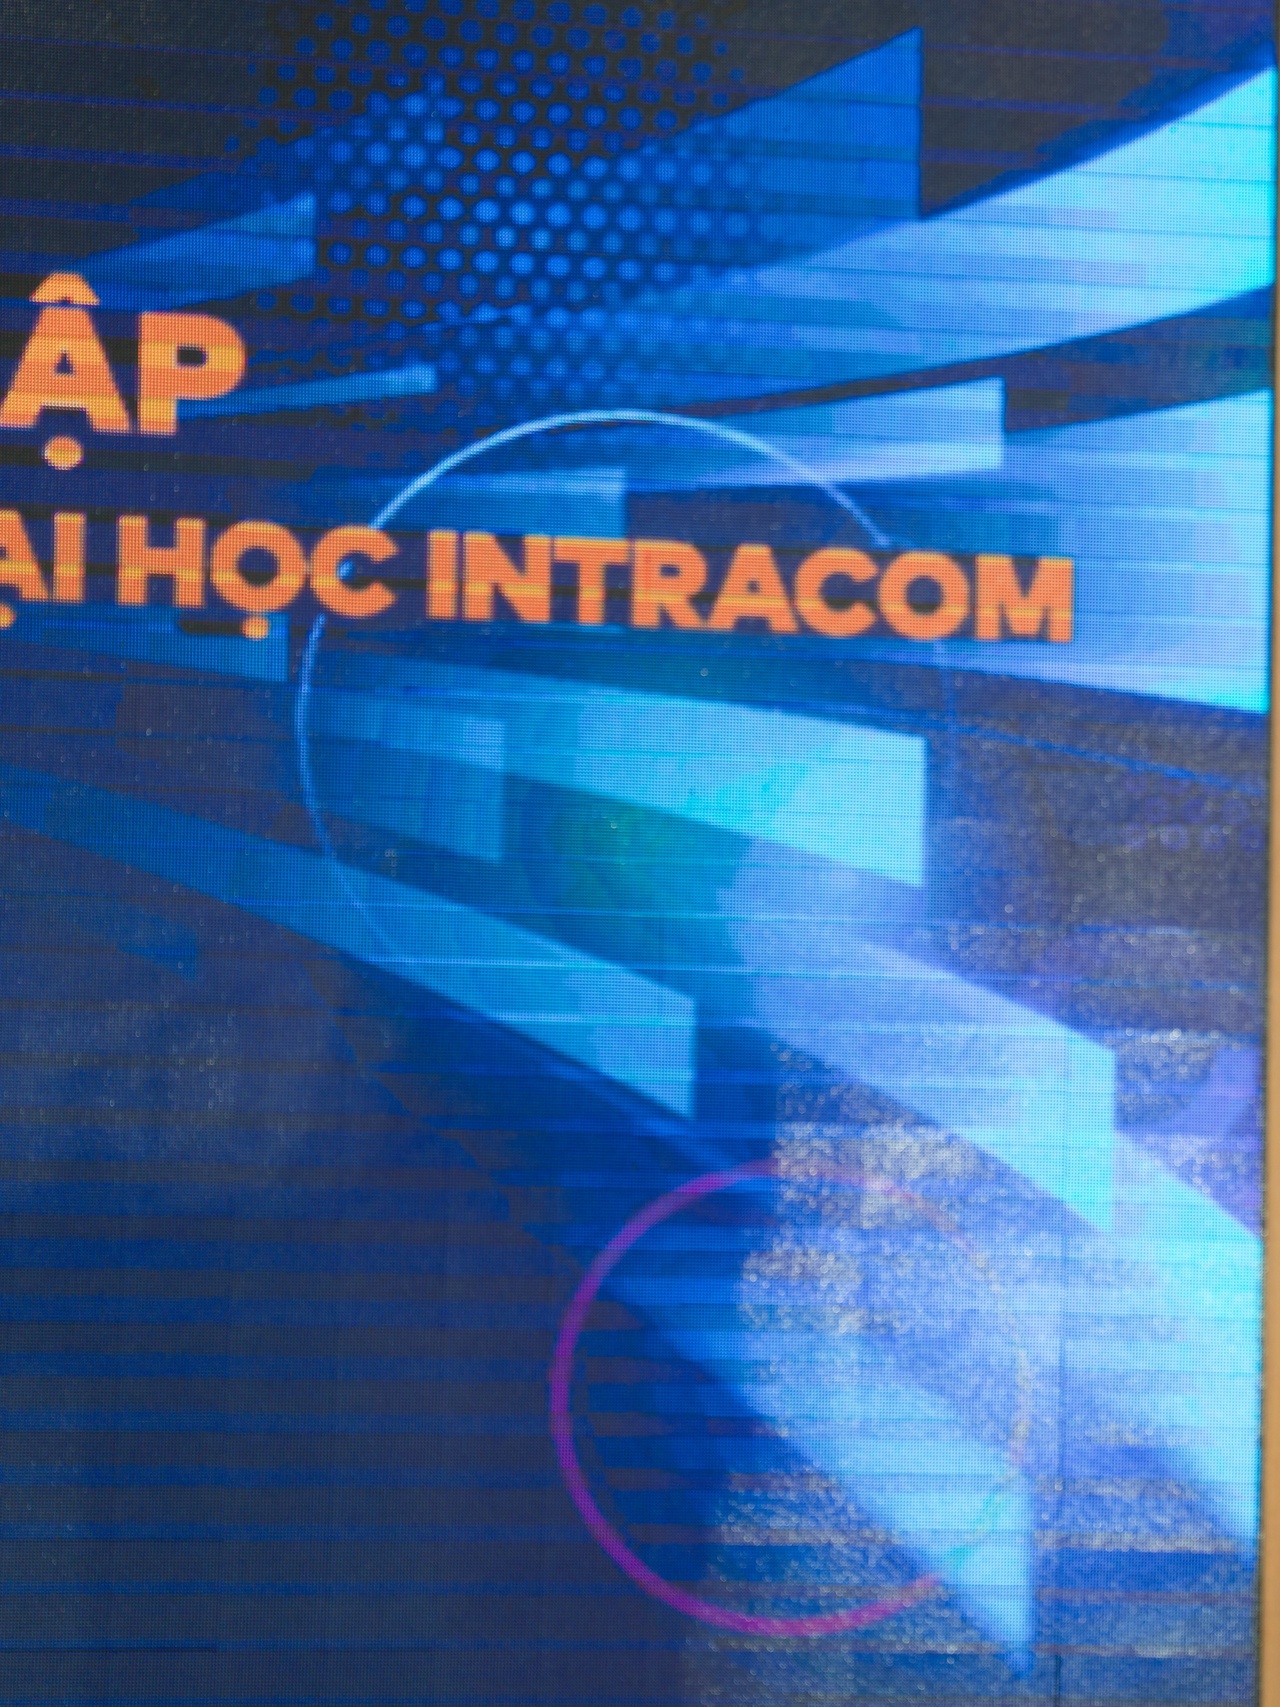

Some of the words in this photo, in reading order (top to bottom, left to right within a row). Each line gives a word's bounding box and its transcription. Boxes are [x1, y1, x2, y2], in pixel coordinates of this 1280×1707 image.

[0, 272, 247, 471] ẬP
[116, 515, 399, 640] HỌC
[427, 529, 1075, 643] INTRACOM
